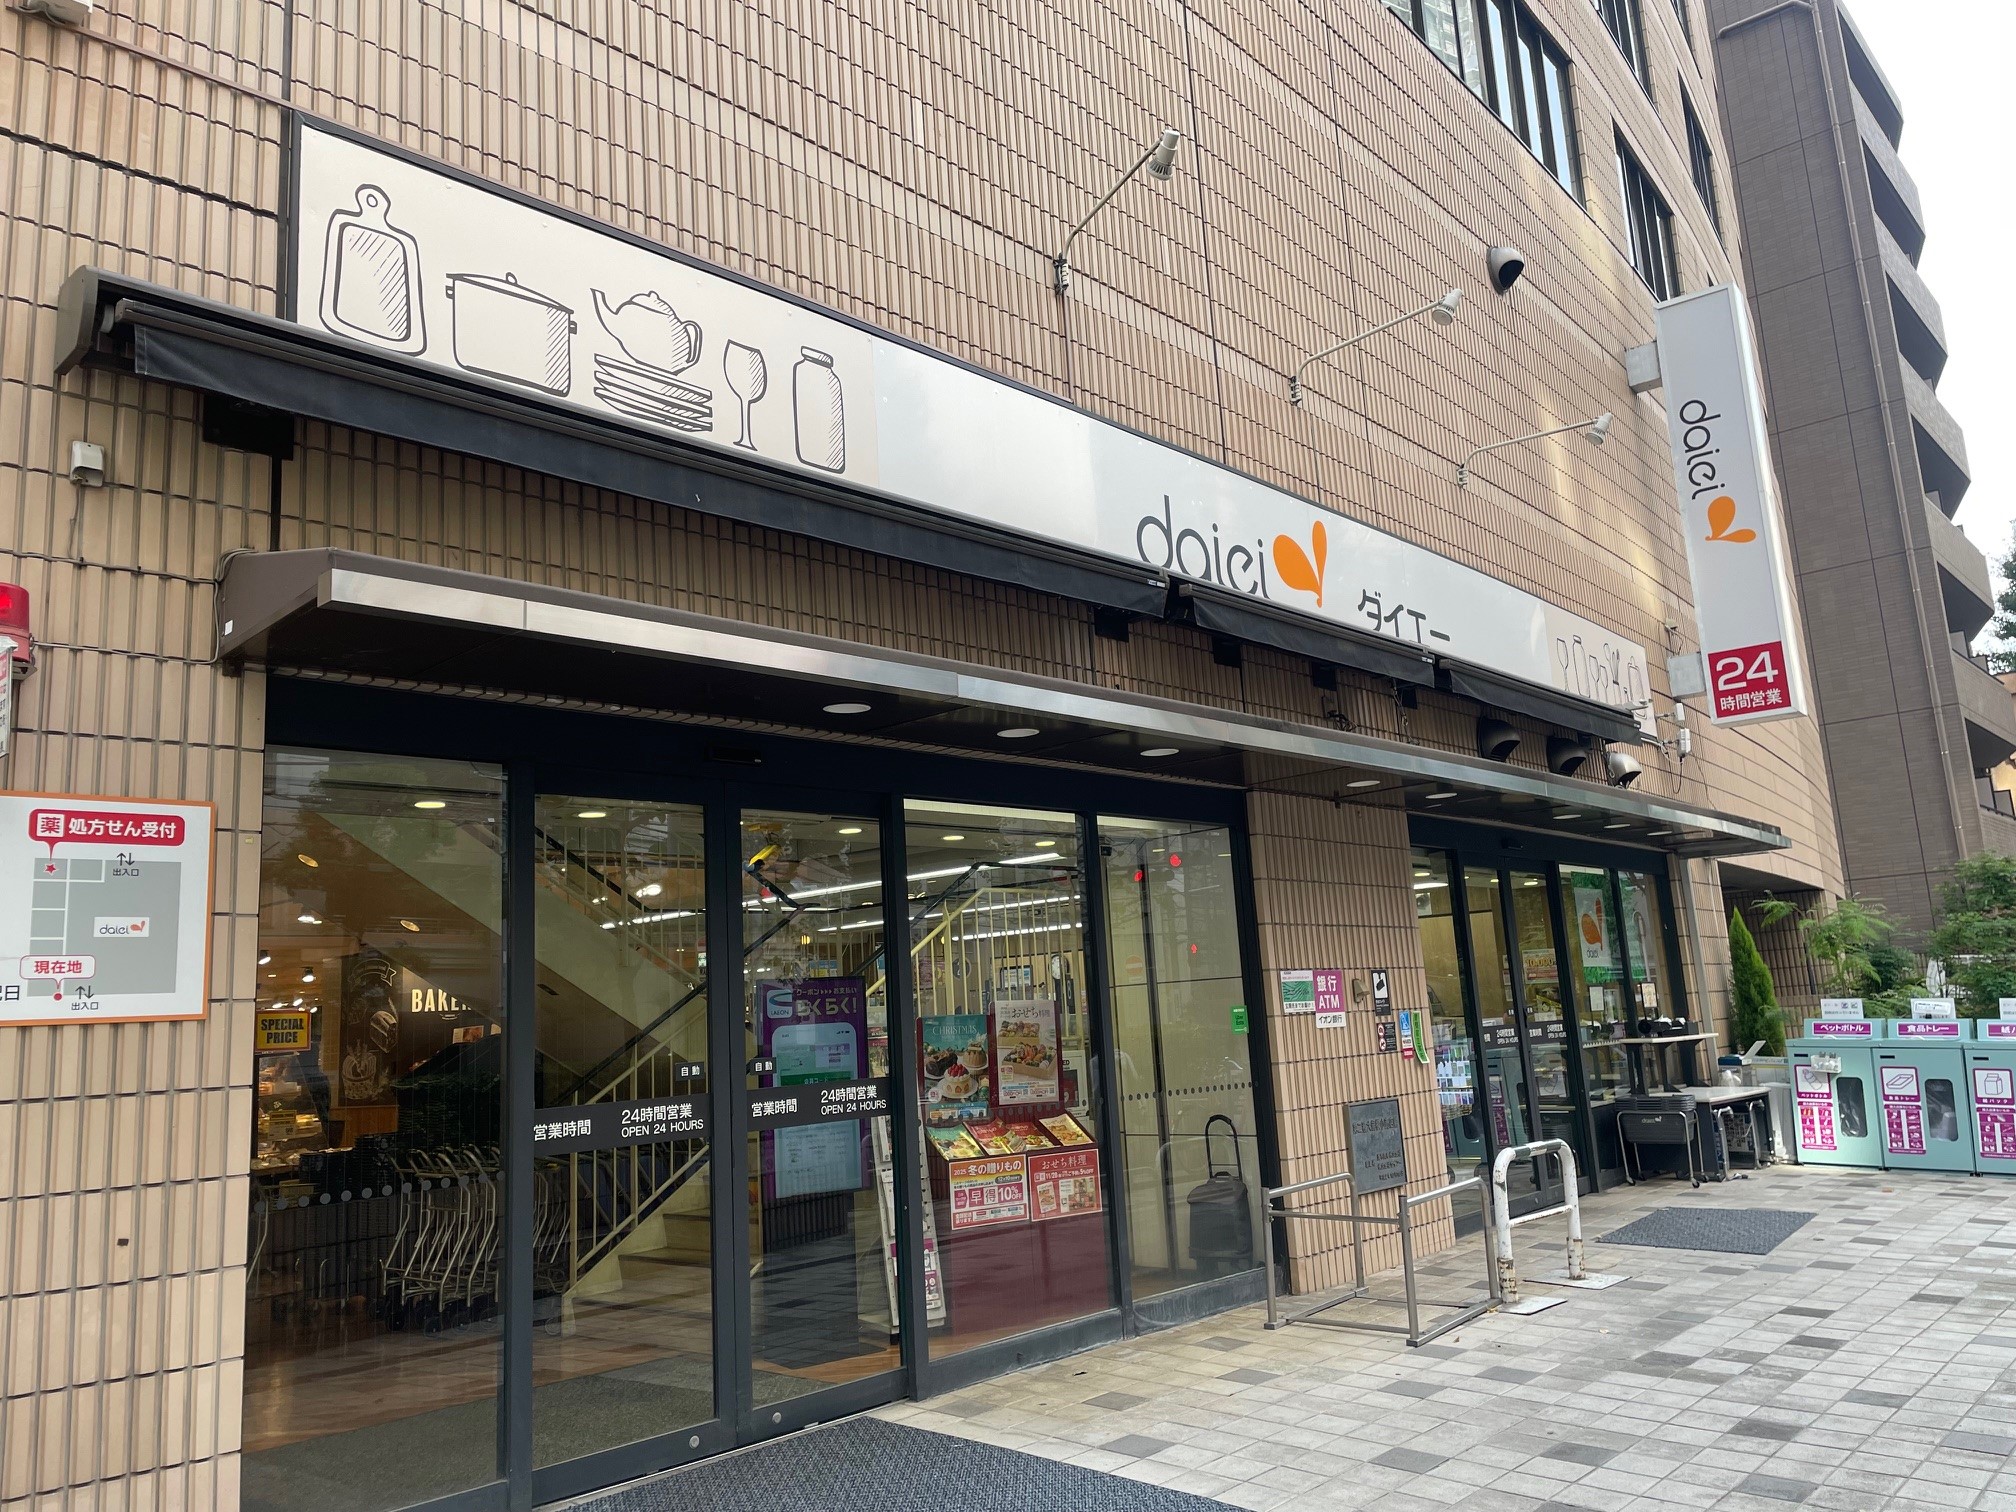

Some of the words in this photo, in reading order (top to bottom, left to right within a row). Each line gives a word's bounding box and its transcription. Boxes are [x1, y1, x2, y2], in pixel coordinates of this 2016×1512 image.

[1680, 399, 1726, 500] daiei
[1136, 494, 1272, 600] daiei
[1358, 588, 1450, 645] ダイエー
[1715, 651, 1779, 691] 24
[1720, 688, 1783, 712] 時間営業
[40, 816, 62, 835] 薬
[68, 817, 177, 839] 処方せん受付
[112, 868, 140, 877] 出入口
[99, 924, 130, 935] daiei
[34, 960, 83, 975] 現在地
[1316, 975, 1337, 992] 銀行
[0, 984, 20, 1001] 日
[71, 1002, 99, 1011] 出入口
[1318, 994, 1340, 1009] ATM
[261, 1017, 304, 1030] SPECIAL
[1318, 1014, 1343, 1024] イオン銀行
[932, 1024, 978, 1035] CHRISTMAS
[1820, 1024, 1864, 1032] ペットボトル
[1906, 1024, 1950, 1033] 食品トレー
[266, 1031, 298, 1044] PRICE
[681, 1065, 700, 1077] 自動
[755, 1061, 773, 1072] 自動
[820, 1085, 878, 1104] 24時間営業
[621, 1103, 693, 1125] 24時間営業
[751, 1098, 798, 1117] 営業時間
[821, 1104, 844, 1115] OPEN
[846, 1103, 857, 1113] 24
[859, 1099, 887, 1111] HOURS
[533, 1119, 592, 1142] 営業時間
[621, 1126, 650, 1138] OPEN
[653, 1123, 667, 1135] 24
[670, 1119, 704, 1132] HOURS
[968, 1160, 1022, 1176] 冬の贈りもの
[1041, 1154, 1087, 1170] おせち料理
